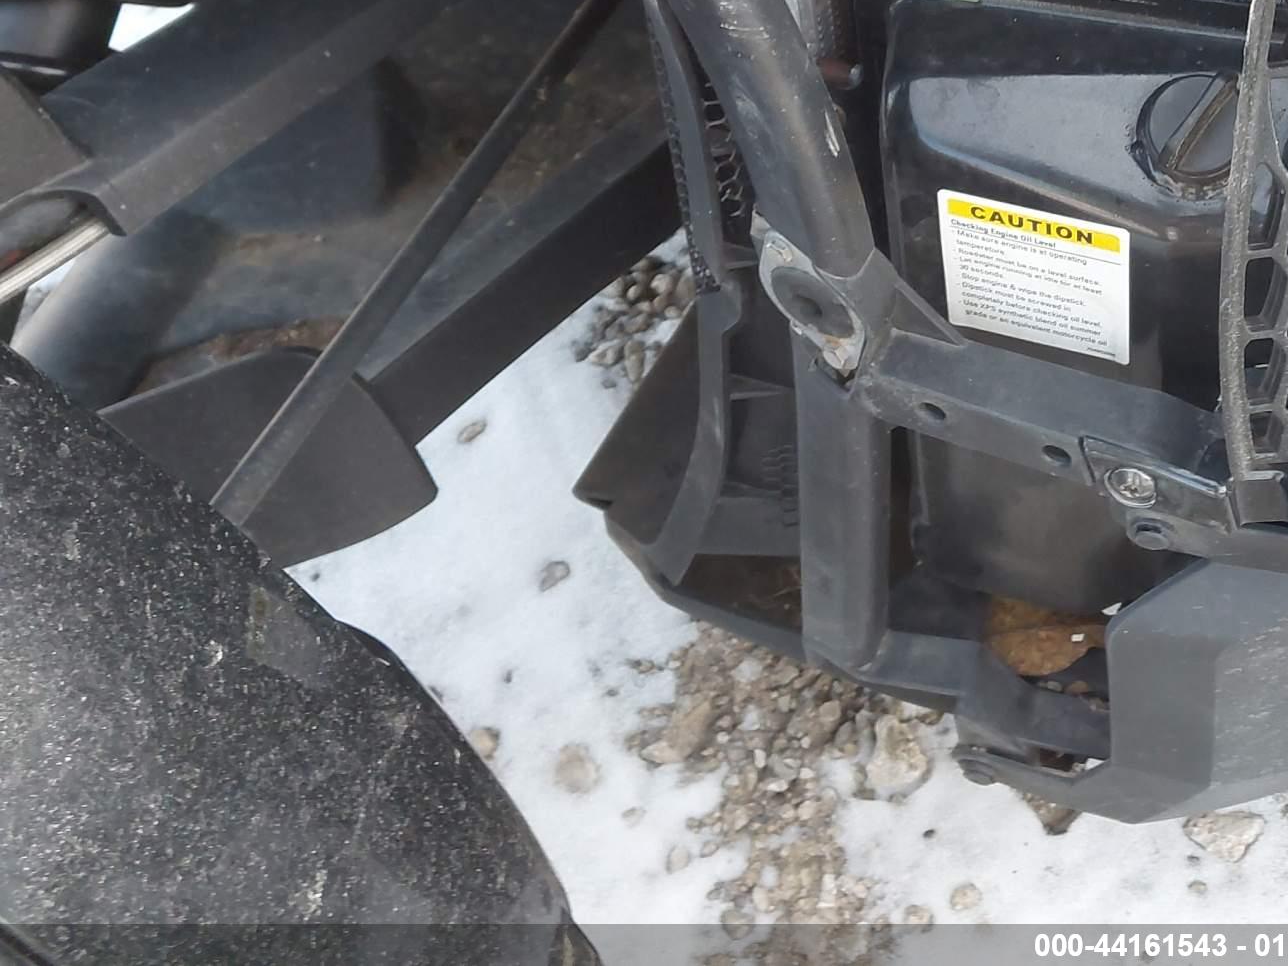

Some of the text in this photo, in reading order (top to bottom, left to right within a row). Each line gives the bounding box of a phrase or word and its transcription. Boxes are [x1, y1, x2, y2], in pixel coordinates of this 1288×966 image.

[951, 219, 989, 235] Checking
[991, 228, 1019, 242] Engine
[1034, 238, 1056, 248] Level
[970, 206, 1093, 244] CAUTION
[957, 229, 979, 240] Make
[1000, 241, 1028, 251] engine
[1049, 252, 1087, 266] operating
[958, 248, 993, 260] Roadster
[1048, 269, 1067, 278] level
[974, 260, 1000, 269] engine
[961, 272, 979, 282] Stop
[981, 278, 1008, 288] engine
[1039, 291, 1052, 299] the
[962, 281, 993, 293] Dipstick
[994, 290, 1014, 299] must
[1028, 298, 1062, 310] screwed
[961, 291, 1004, 306] completely
[1005, 300, 1031, 311] before
[1033, 308, 1069, 321] checking
[963, 299, 978, 308] Use
[998, 308, 1033, 321] synthetic
[1035, 316, 1057, 326] blend
[1070, 325, 1101, 336] summer
[965, 309, 987, 318] grade
[1010, 320, 1051, 333] equivalent
[1052, 330, 1096, 344] motorcycle
